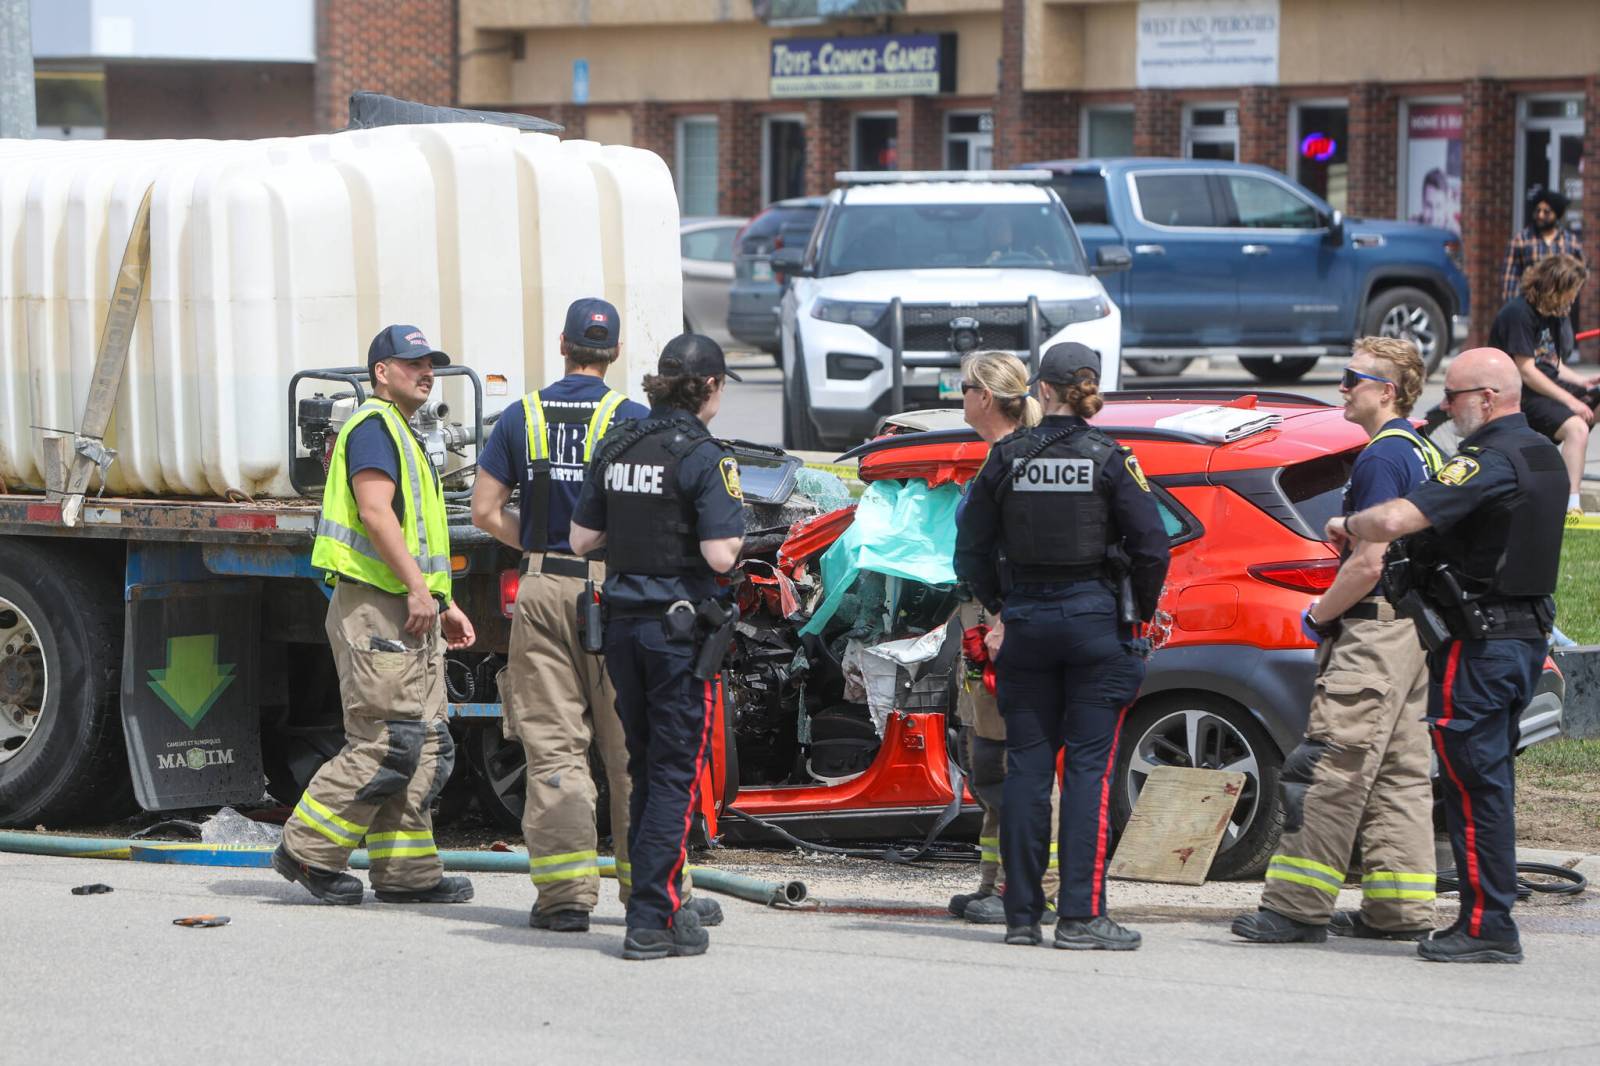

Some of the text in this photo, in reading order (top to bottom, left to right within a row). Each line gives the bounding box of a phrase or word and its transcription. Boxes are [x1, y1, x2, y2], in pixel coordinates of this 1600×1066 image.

[603, 463, 664, 495] POLICE
[1014, 464, 1090, 485] POLICE
[156, 747, 235, 771] MAXIM
